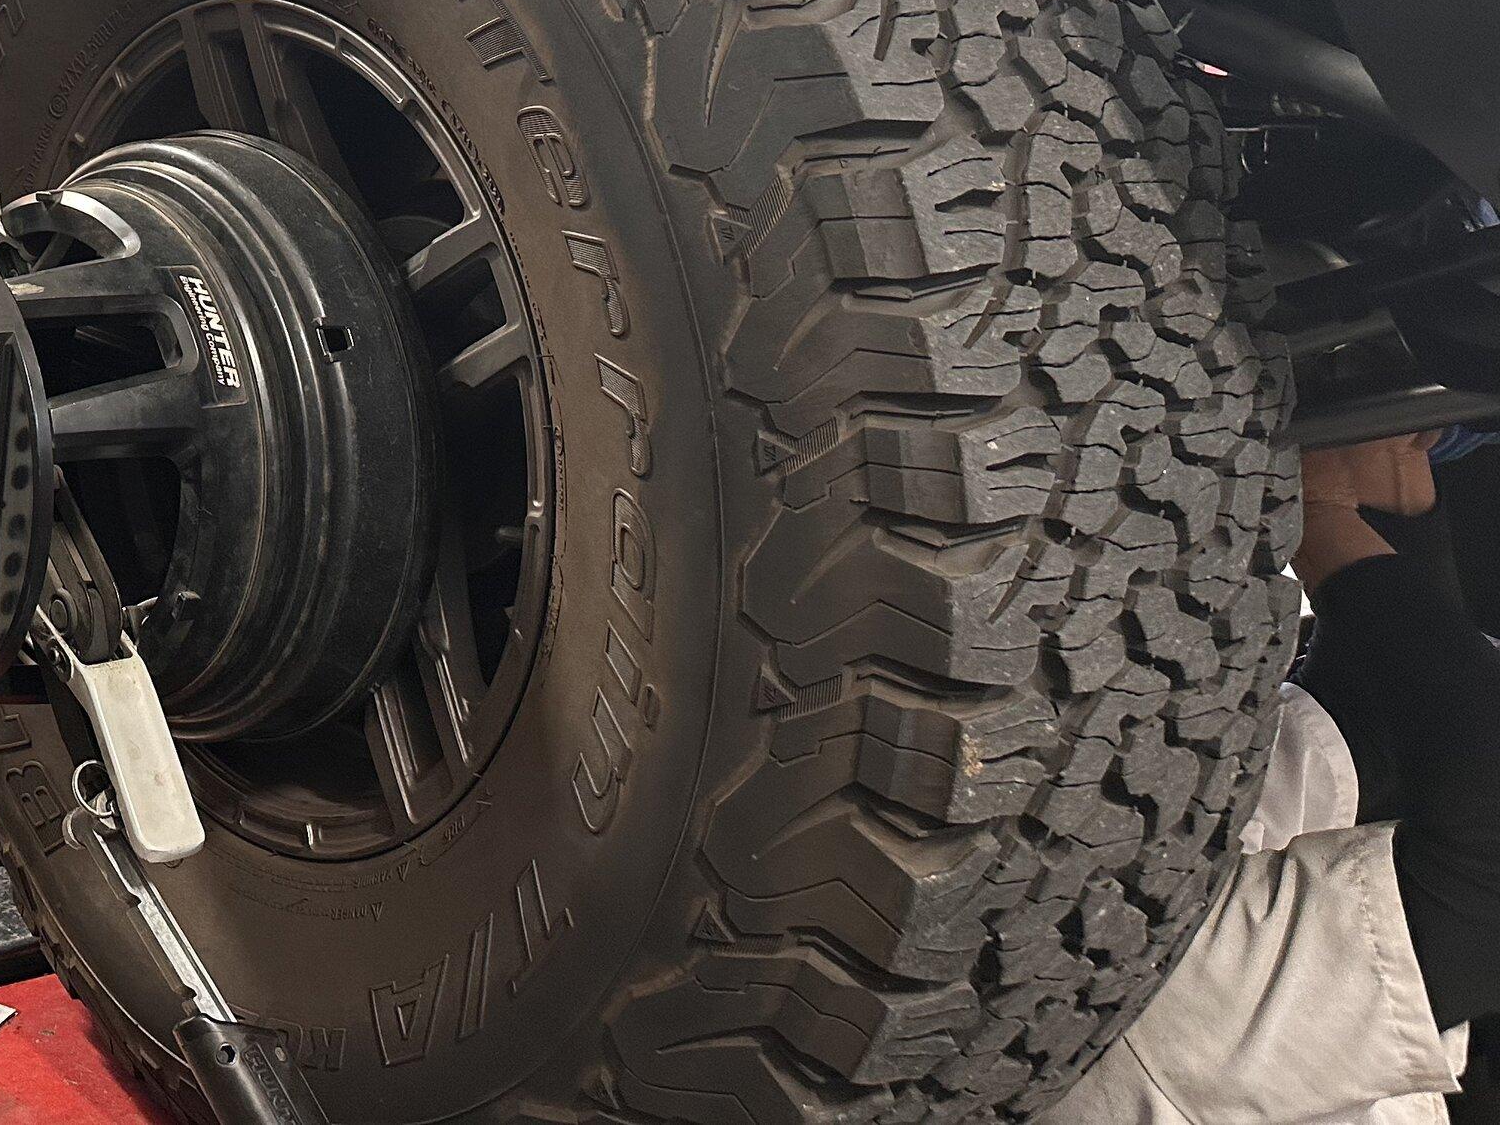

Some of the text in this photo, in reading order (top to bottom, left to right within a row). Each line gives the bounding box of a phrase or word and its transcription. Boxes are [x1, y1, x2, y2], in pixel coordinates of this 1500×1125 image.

[180, 276, 228, 386] Engineering Company
[181, 277, 242, 391] HUNTER
[369, 860, 577, 1067] T/A
